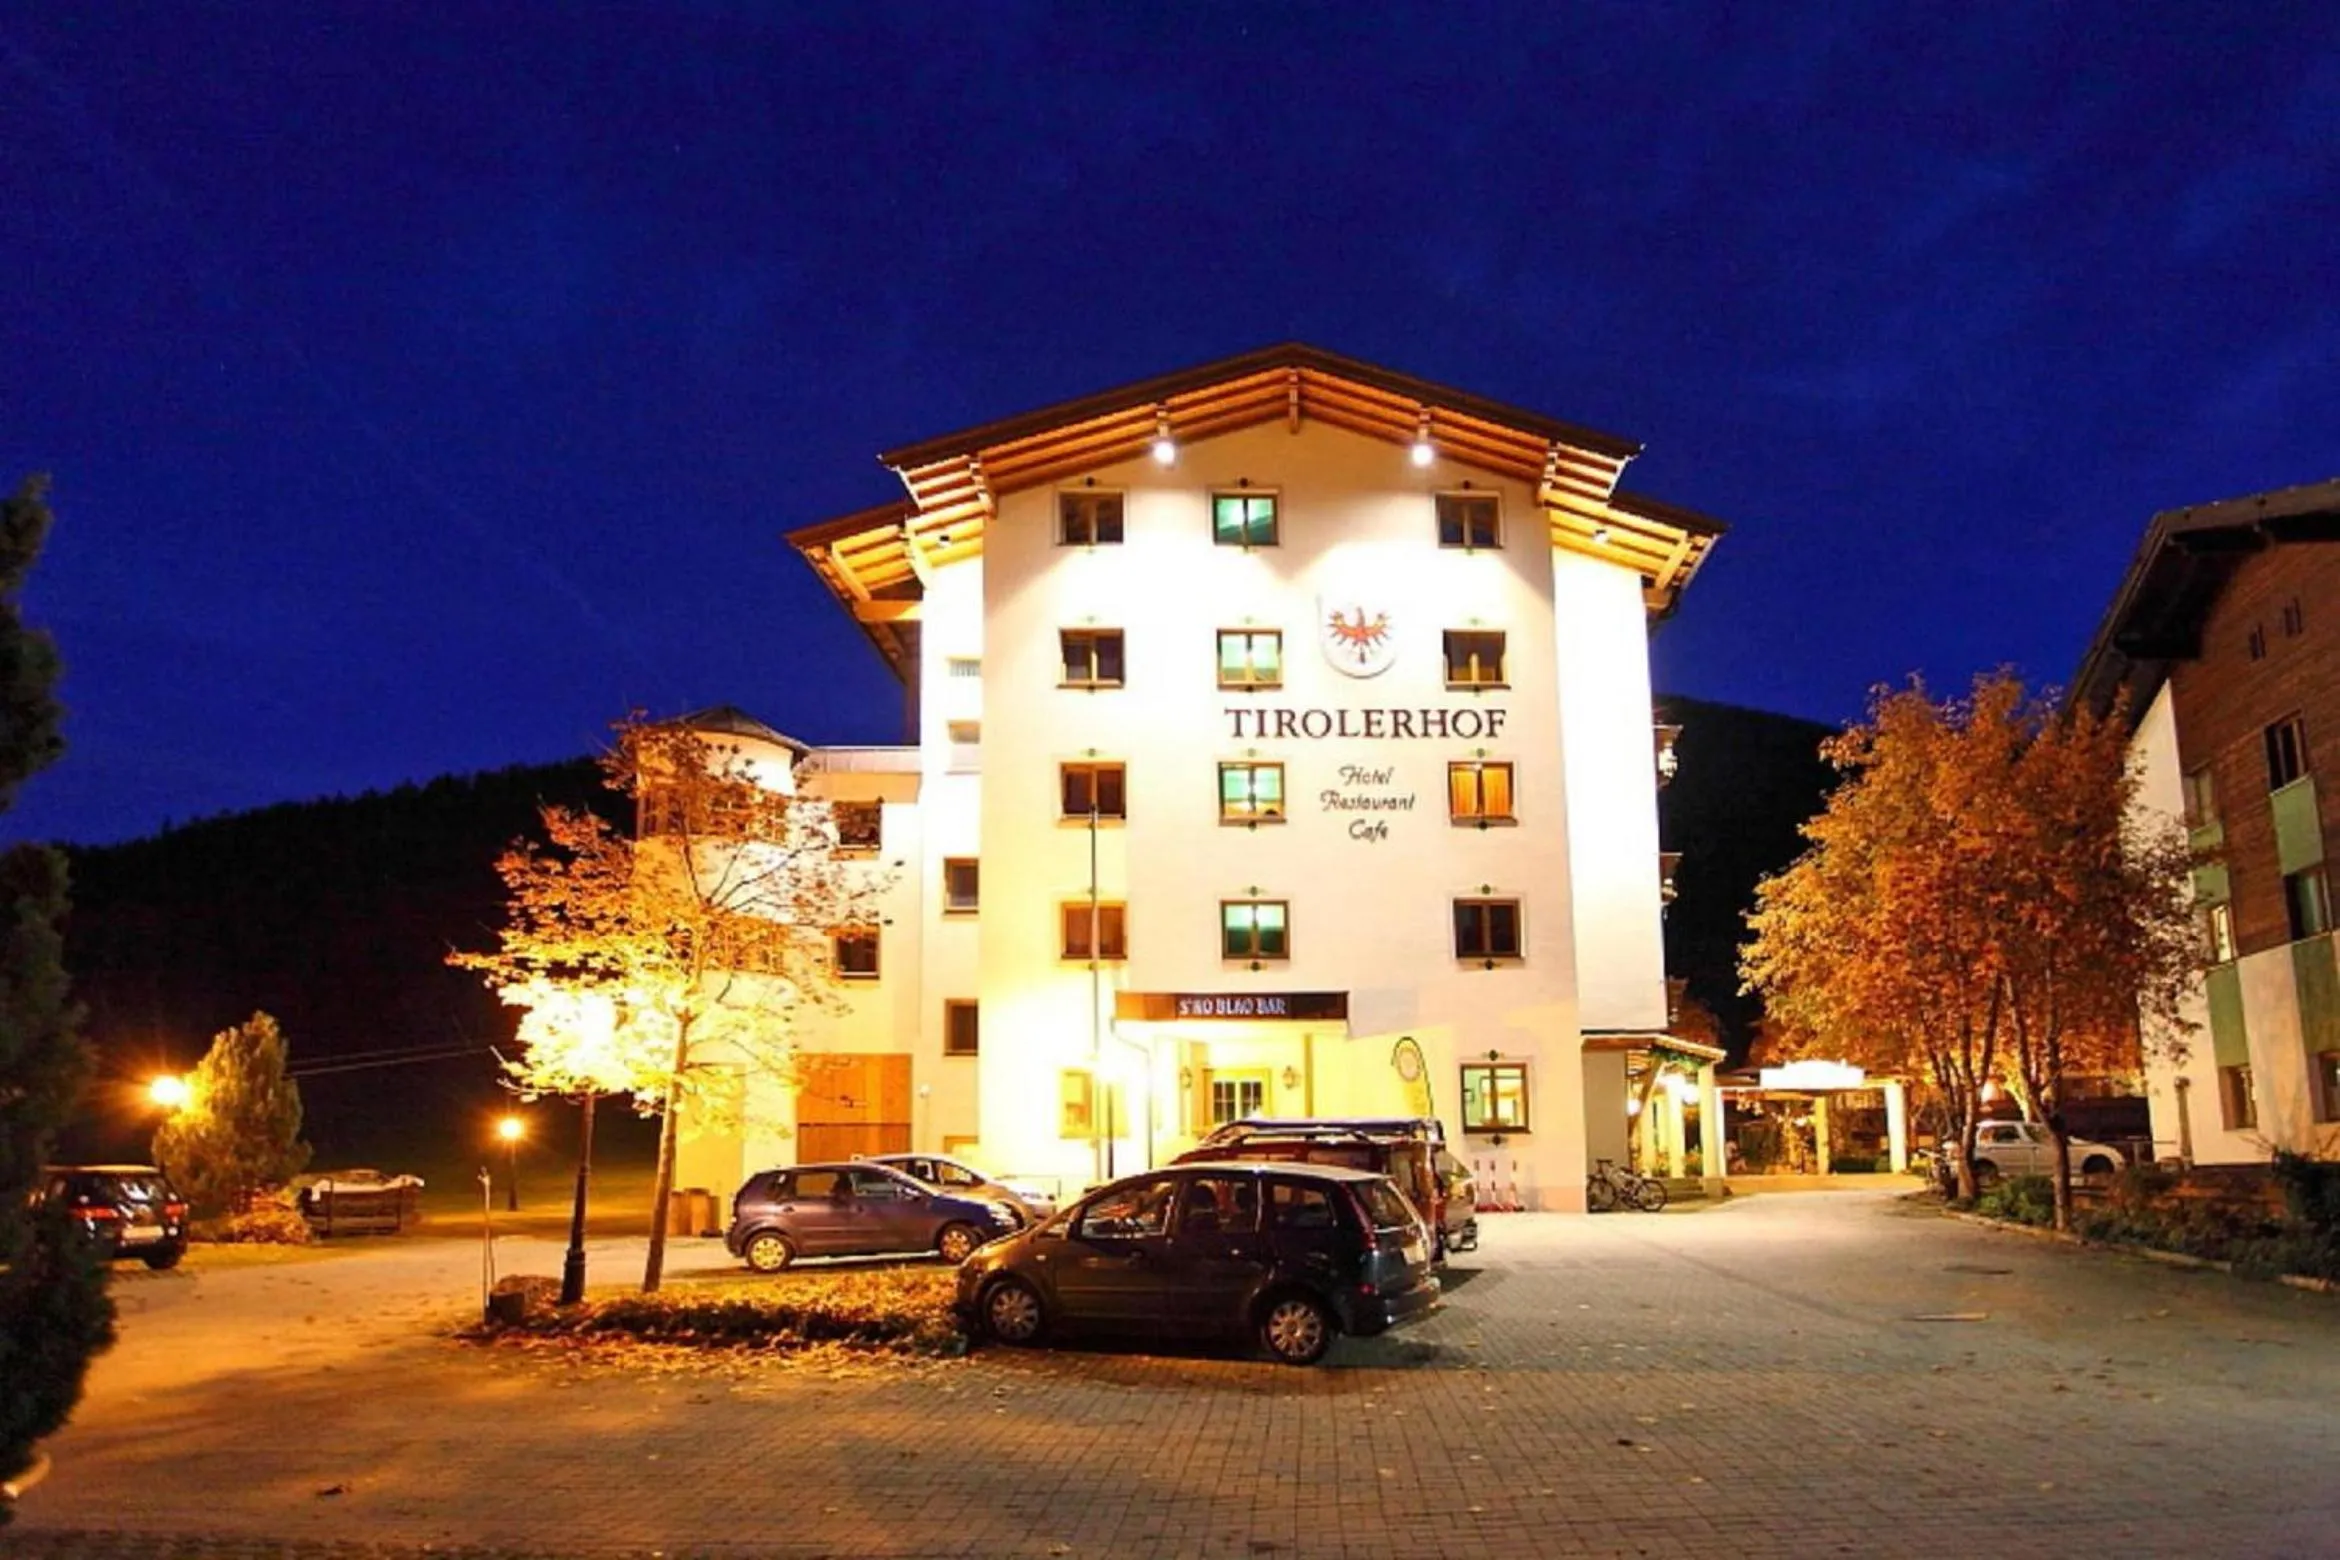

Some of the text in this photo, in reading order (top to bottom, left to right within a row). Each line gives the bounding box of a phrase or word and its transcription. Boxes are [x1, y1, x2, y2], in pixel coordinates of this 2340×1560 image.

[1224, 708, 1507, 739] TIROLERHOF
[1338, 764, 1395, 786] Hotel
[1320, 789, 1416, 812] Restaurant
